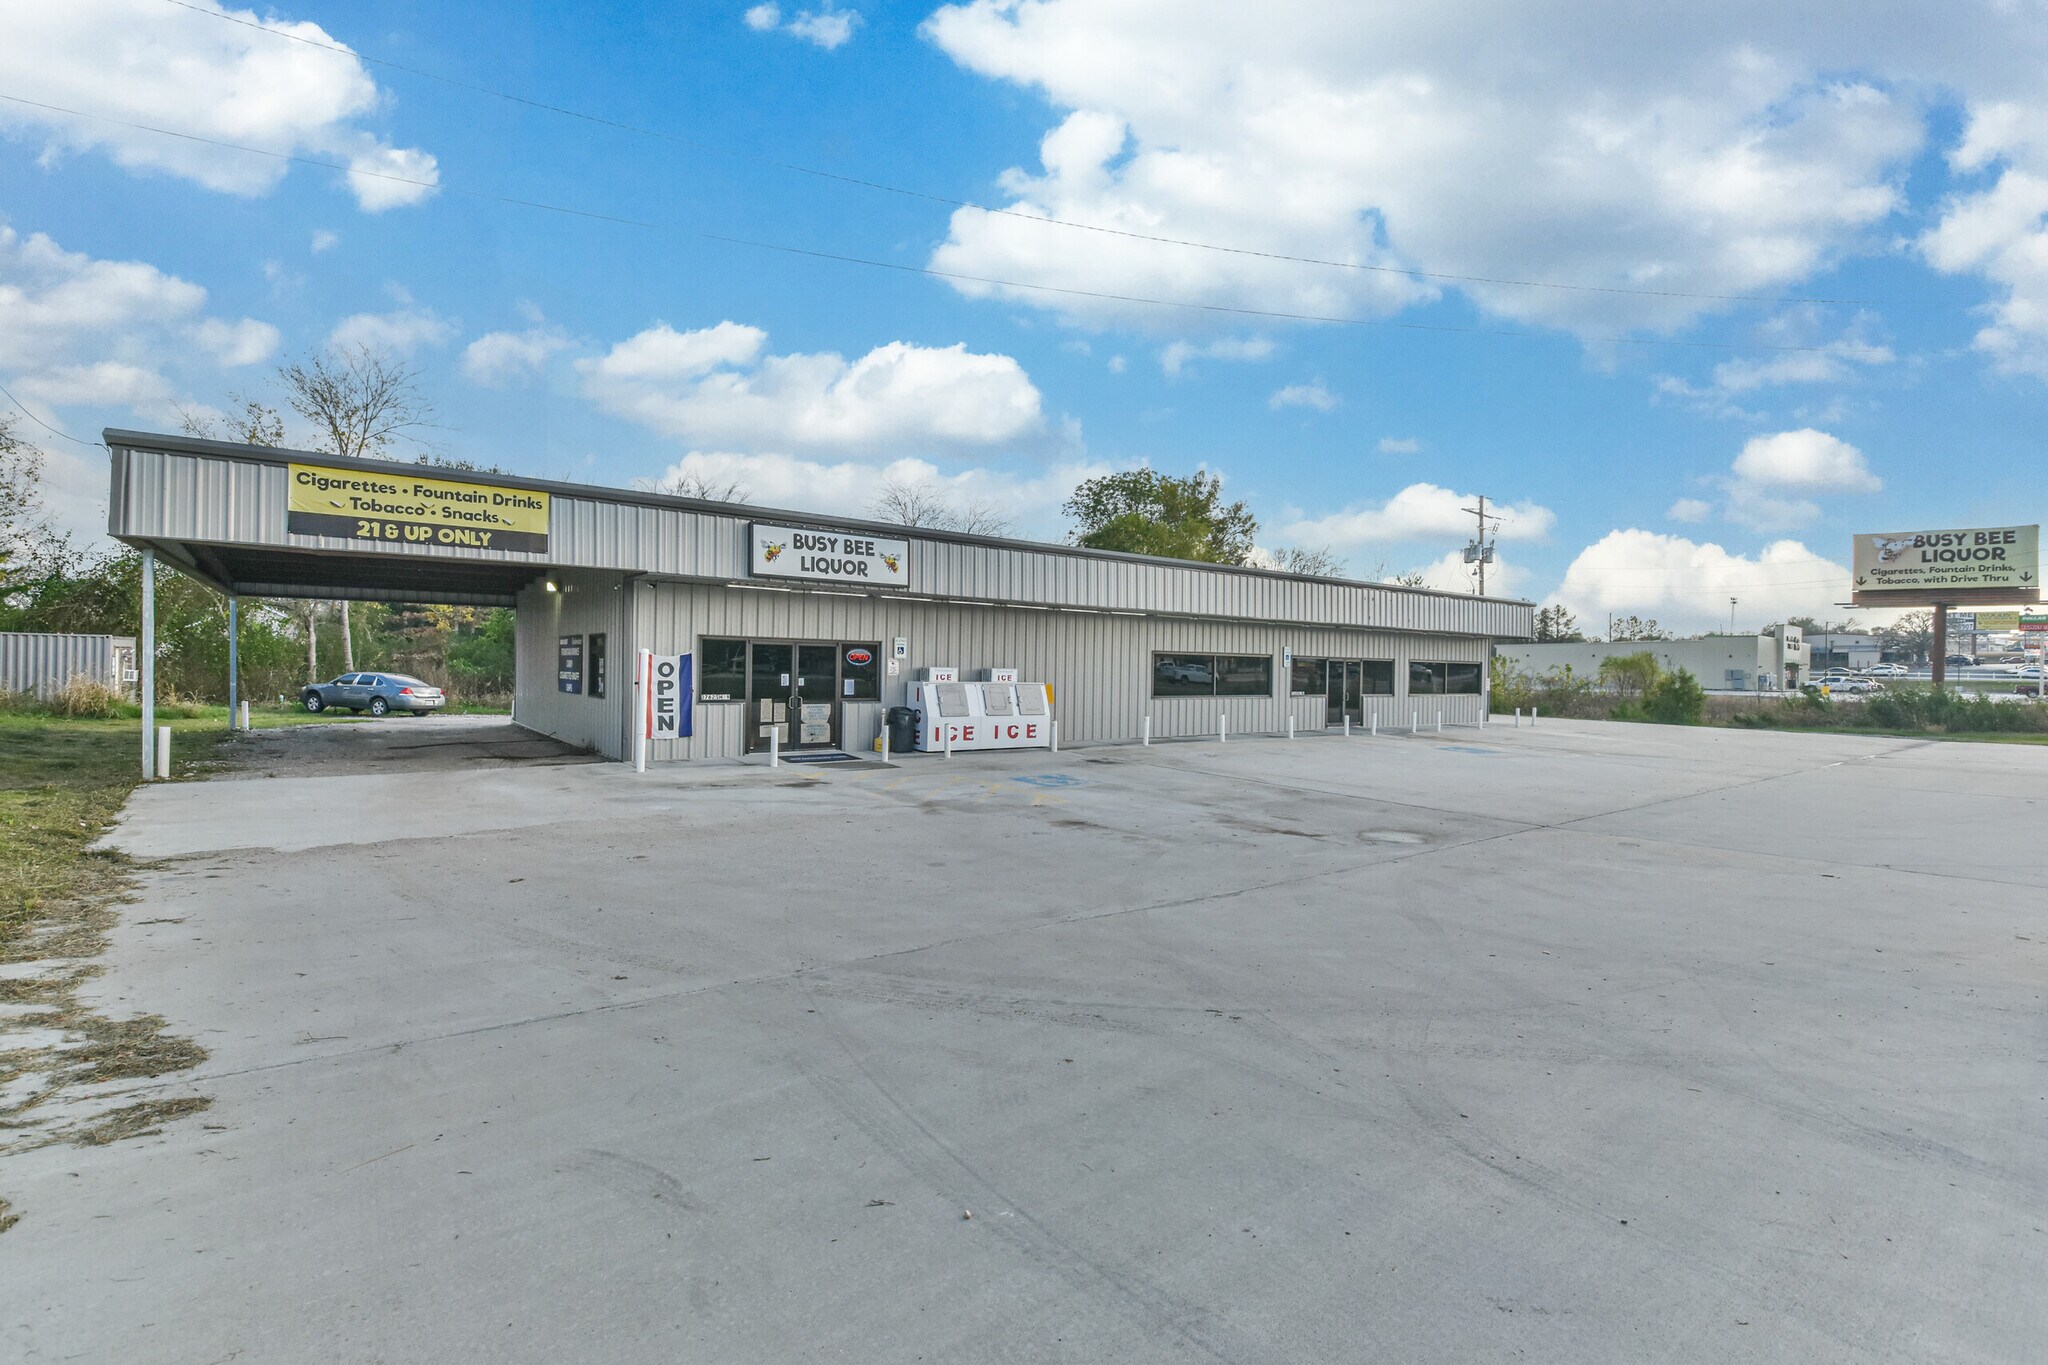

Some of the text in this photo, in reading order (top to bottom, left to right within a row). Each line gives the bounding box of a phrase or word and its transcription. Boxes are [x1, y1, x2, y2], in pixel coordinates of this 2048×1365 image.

[296, 472, 543, 510] Cigarettes Fountain Drinks
[349, 496, 499, 523] Tobacco Snacks
[356, 520, 492, 546] 21 & UP ONLY
[1913, 530, 2016, 548] BUSY BEE
[793, 533, 875, 557] BUSY BEE
[1921, 547, 2006, 563] LIQUOR
[800, 555, 868, 578] LIQUOR
[1870, 563, 2016, 577] Cigarettes, Fountain Drinks,
[1876, 574, 2009, 585] Tobacco, with Drive Thru
[849, 652, 869, 661] OPEN
[935, 673, 952, 681] ICE
[997, 674, 1012, 682] ICE
[657, 662, 675, 731] OPEN
[994, 723, 1037, 740] ICE
